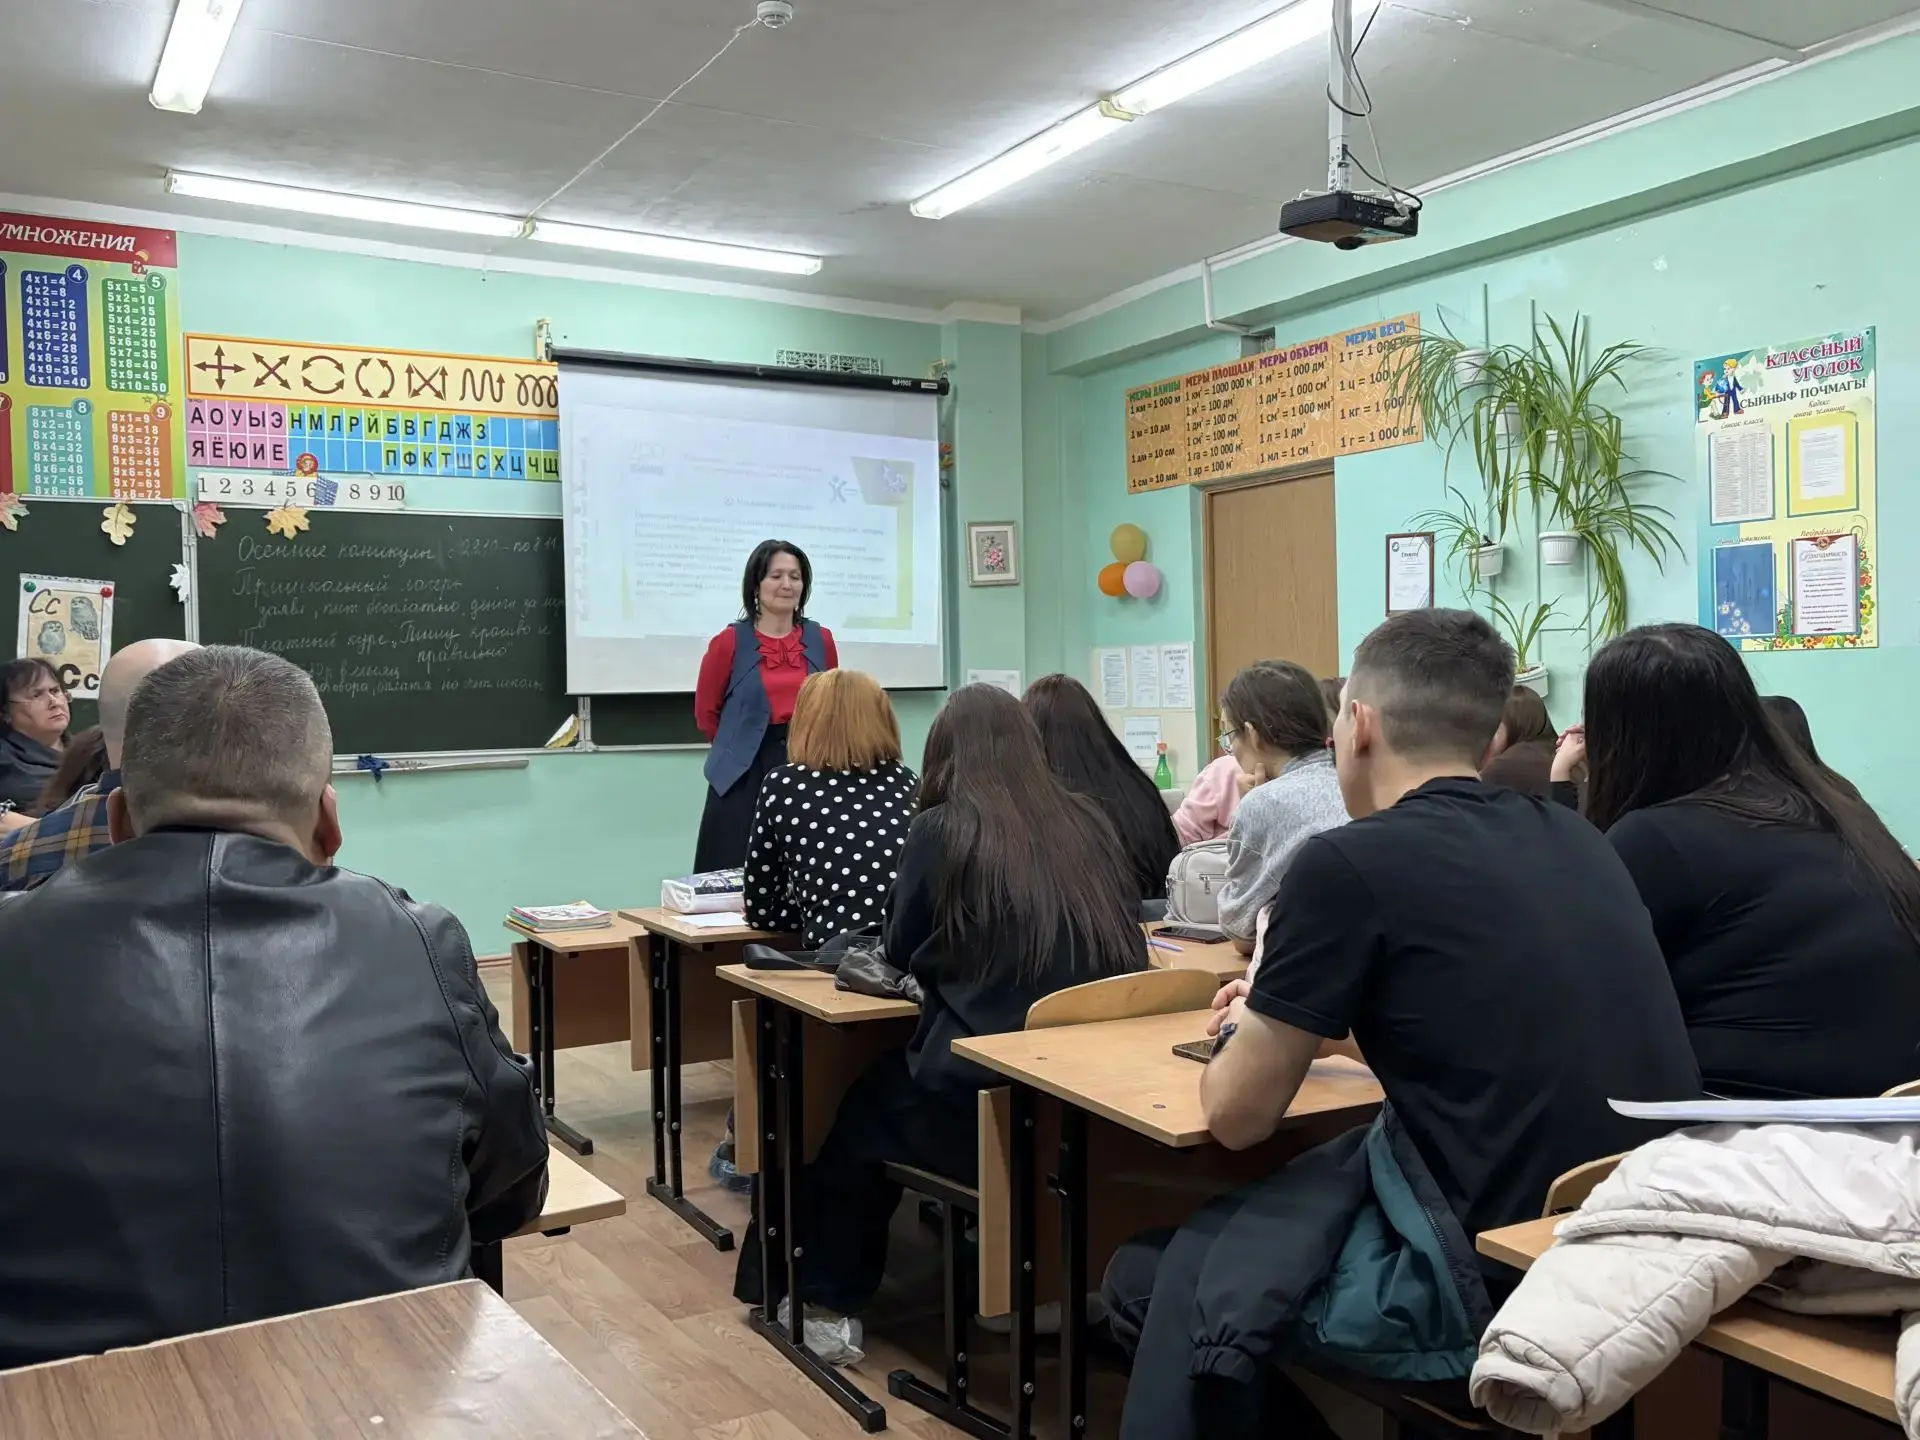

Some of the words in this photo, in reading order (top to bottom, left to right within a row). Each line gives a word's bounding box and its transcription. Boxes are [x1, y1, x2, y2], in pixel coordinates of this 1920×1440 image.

[72, 268, 82, 281] 4
[151, 276, 161, 288] 5
[1345, 328, 1376, 346] МЕРЫ
[1260, 351, 1287, 369] МЕРЫ
[1290, 341, 1328, 361] ОБЪЕМА
[1766, 336, 1864, 368] КЛАССНЫЙ
[1186, 372, 1209, 388] МЕРЫ
[1212, 361, 1254, 381] ПЛОЩАДИ
[1792, 356, 1863, 383] УГОЛОК
[1129, 388, 1151, 401] МЕРЫ
[1740, 390, 1797, 409] СЫЙНЫФ
[1800, 378, 1866, 398] ПОЧМАГЫ
[78, 402, 86, 414] 8
[156, 406, 165, 418] 9
[199, 478, 208, 493] 1
[220, 478, 231, 493] 2
[242, 479, 253, 495] 3
[265, 481, 275, 496] 4
[286, 482, 296, 497] 5
[307, 482, 316, 497] 6
[350, 484, 360, 499] 8
[370, 485, 380, 500] 9
[388, 485, 404, 501] 10
[238, 534, 329, 562] Осенние
